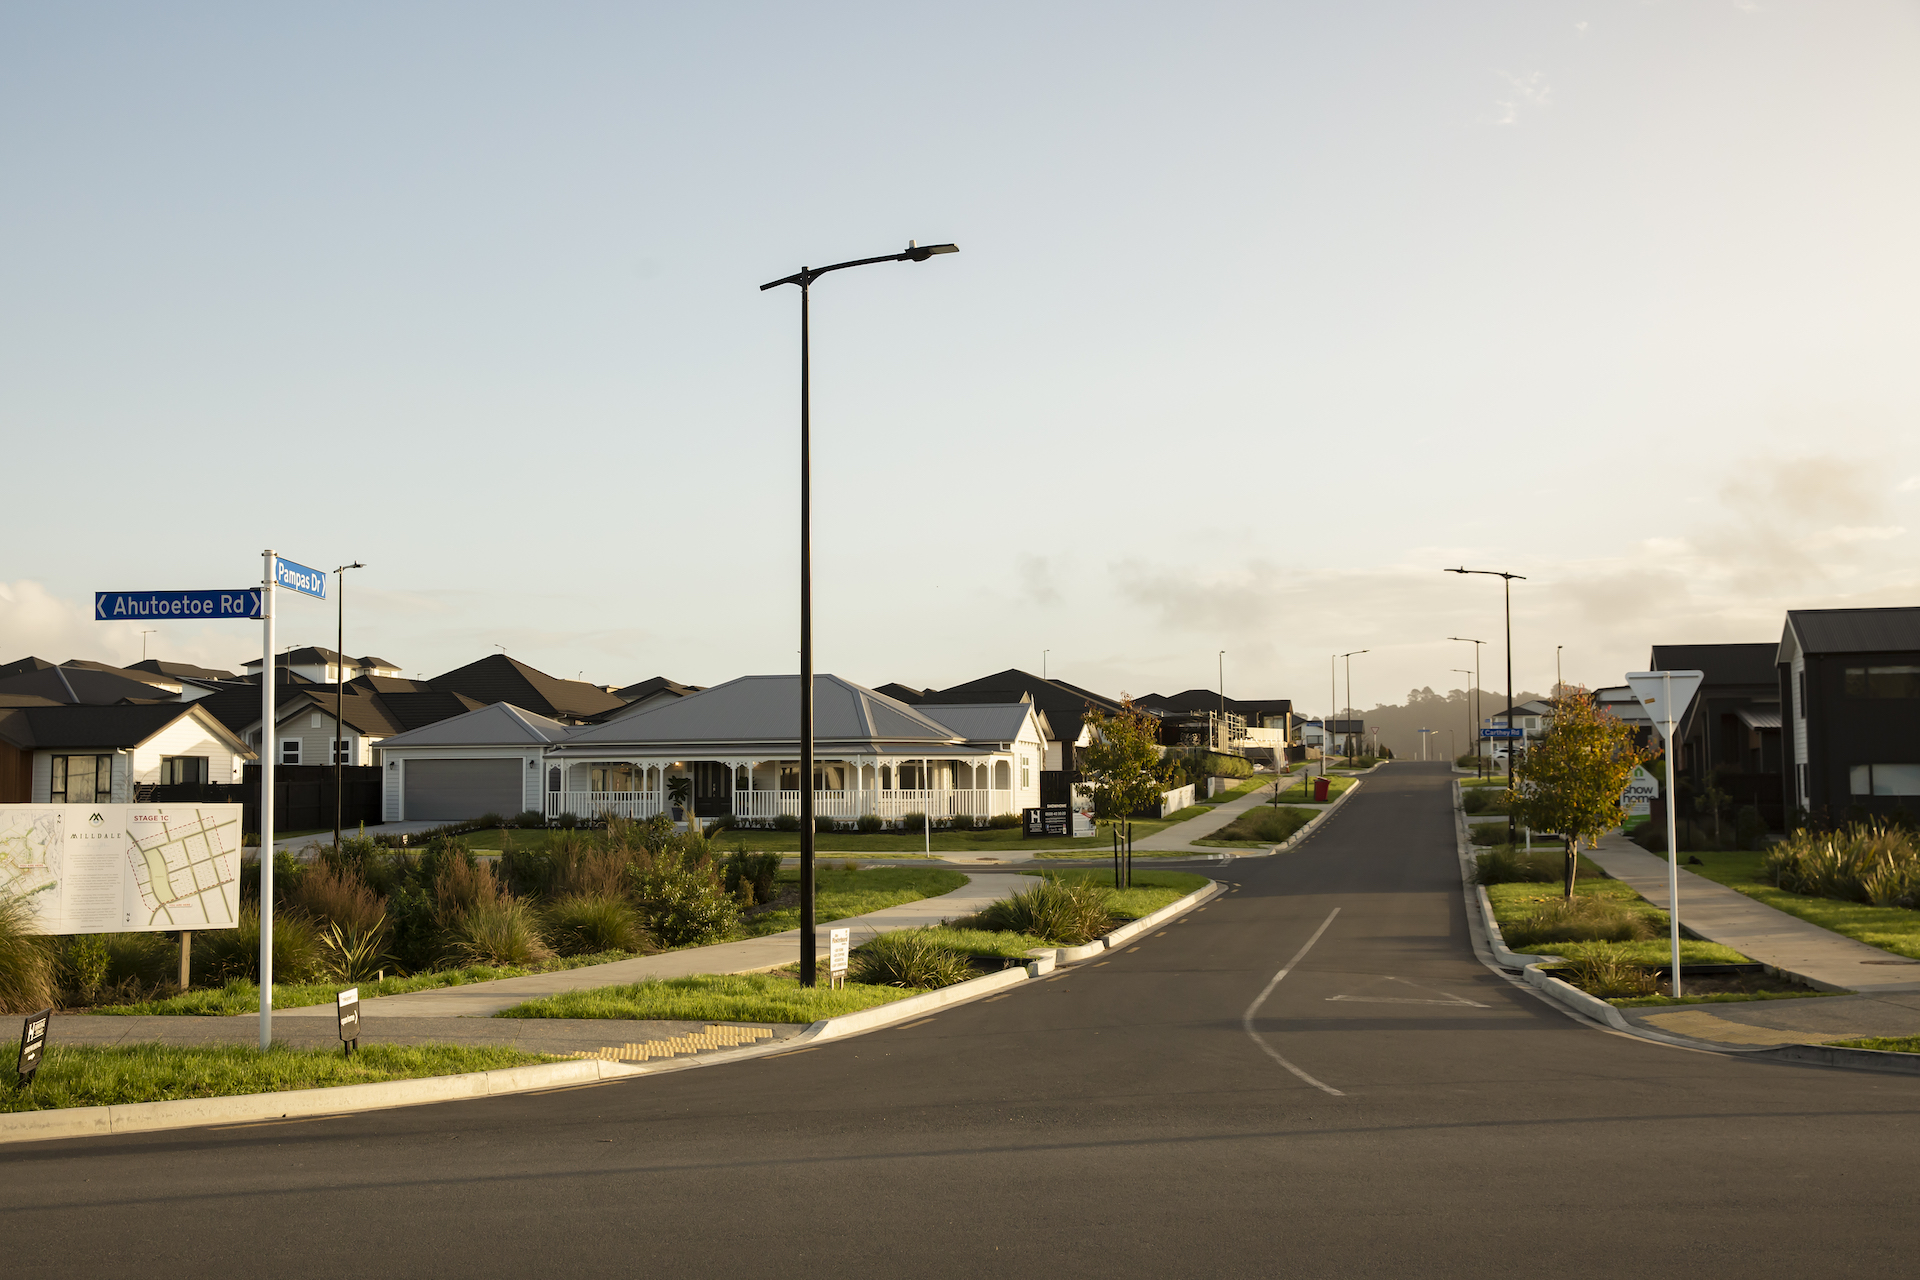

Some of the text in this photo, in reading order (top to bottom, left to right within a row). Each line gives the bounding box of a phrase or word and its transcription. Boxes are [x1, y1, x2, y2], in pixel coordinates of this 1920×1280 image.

[278, 562, 321, 593] Pampas Dr
[113, 594, 244, 616] Ahutoetoe Rd
[1624, 785, 1653, 794] show
